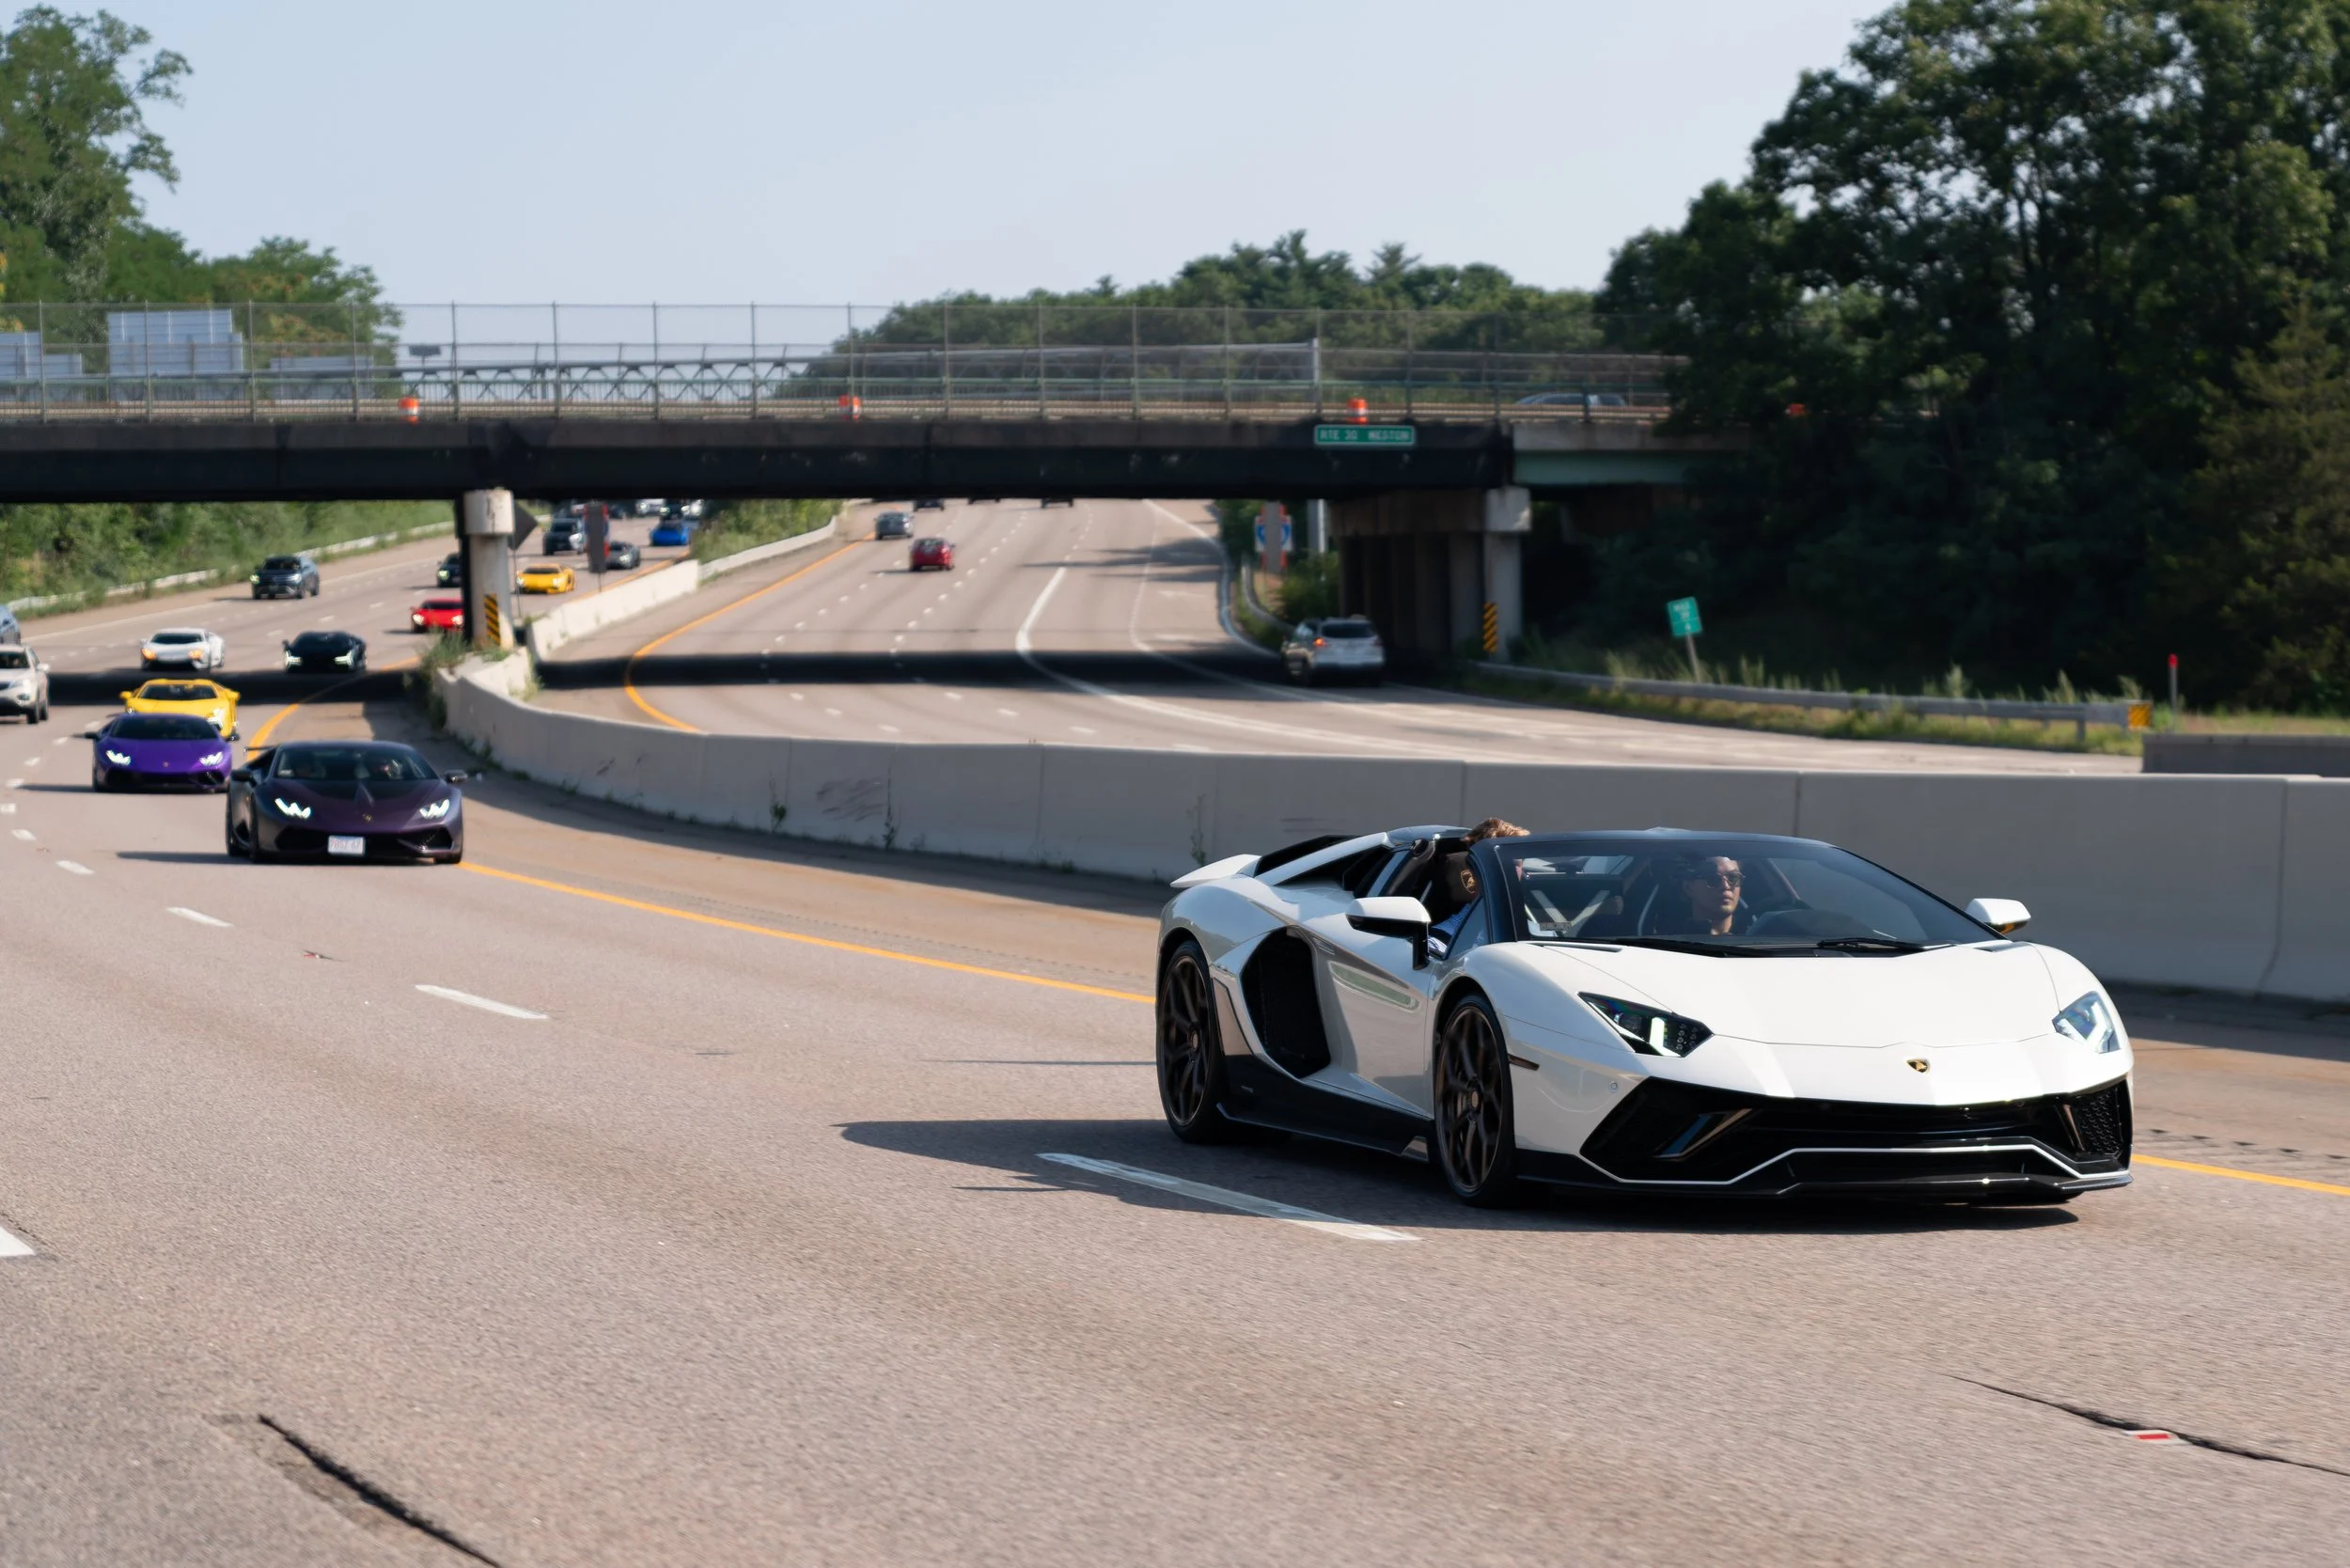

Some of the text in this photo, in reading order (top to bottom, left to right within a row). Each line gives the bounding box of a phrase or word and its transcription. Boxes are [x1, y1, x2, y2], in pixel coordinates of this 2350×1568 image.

[1320, 430, 1409, 441] RTE 30 WESTON
